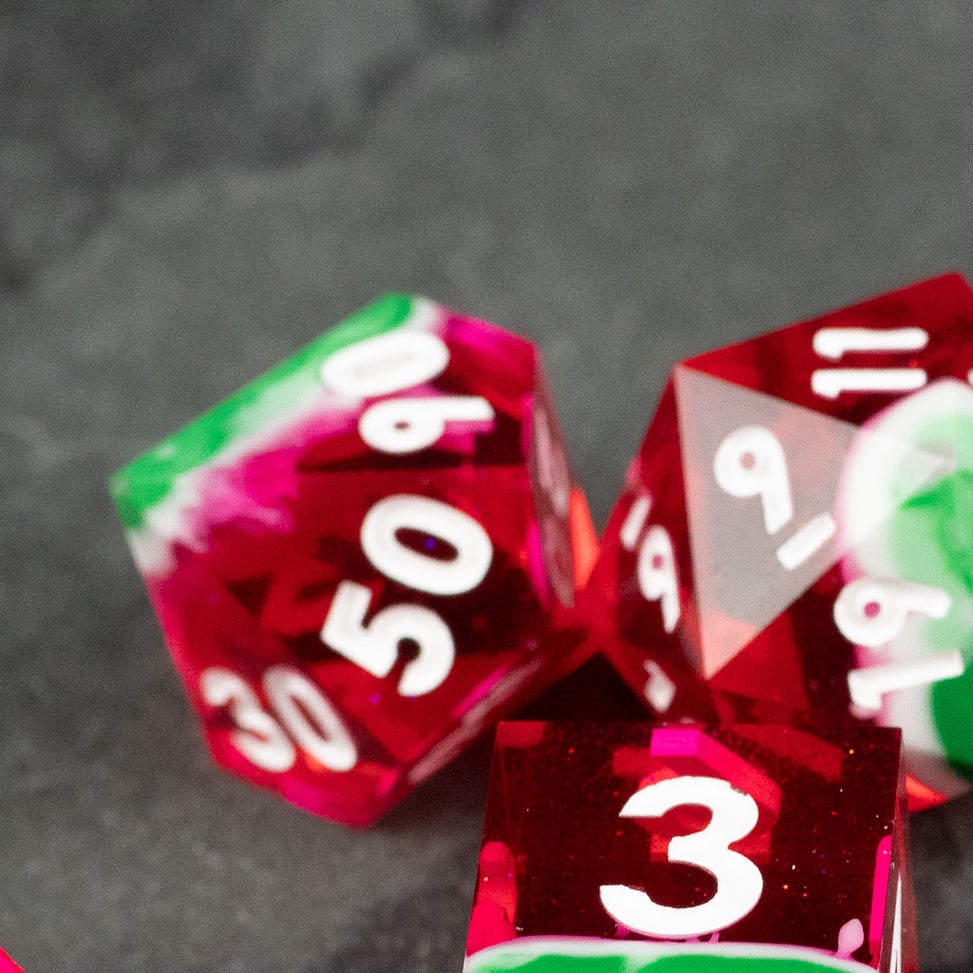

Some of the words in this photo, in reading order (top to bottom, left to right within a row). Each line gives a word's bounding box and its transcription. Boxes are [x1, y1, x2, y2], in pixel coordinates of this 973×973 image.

[320, 330, 494, 453] 90
[811, 327, 928, 400] 11
[320, 495, 493, 698] 50
[833, 577, 965, 713] 19
[200, 667, 358, 773] 30
[599, 776, 764, 937] 3
